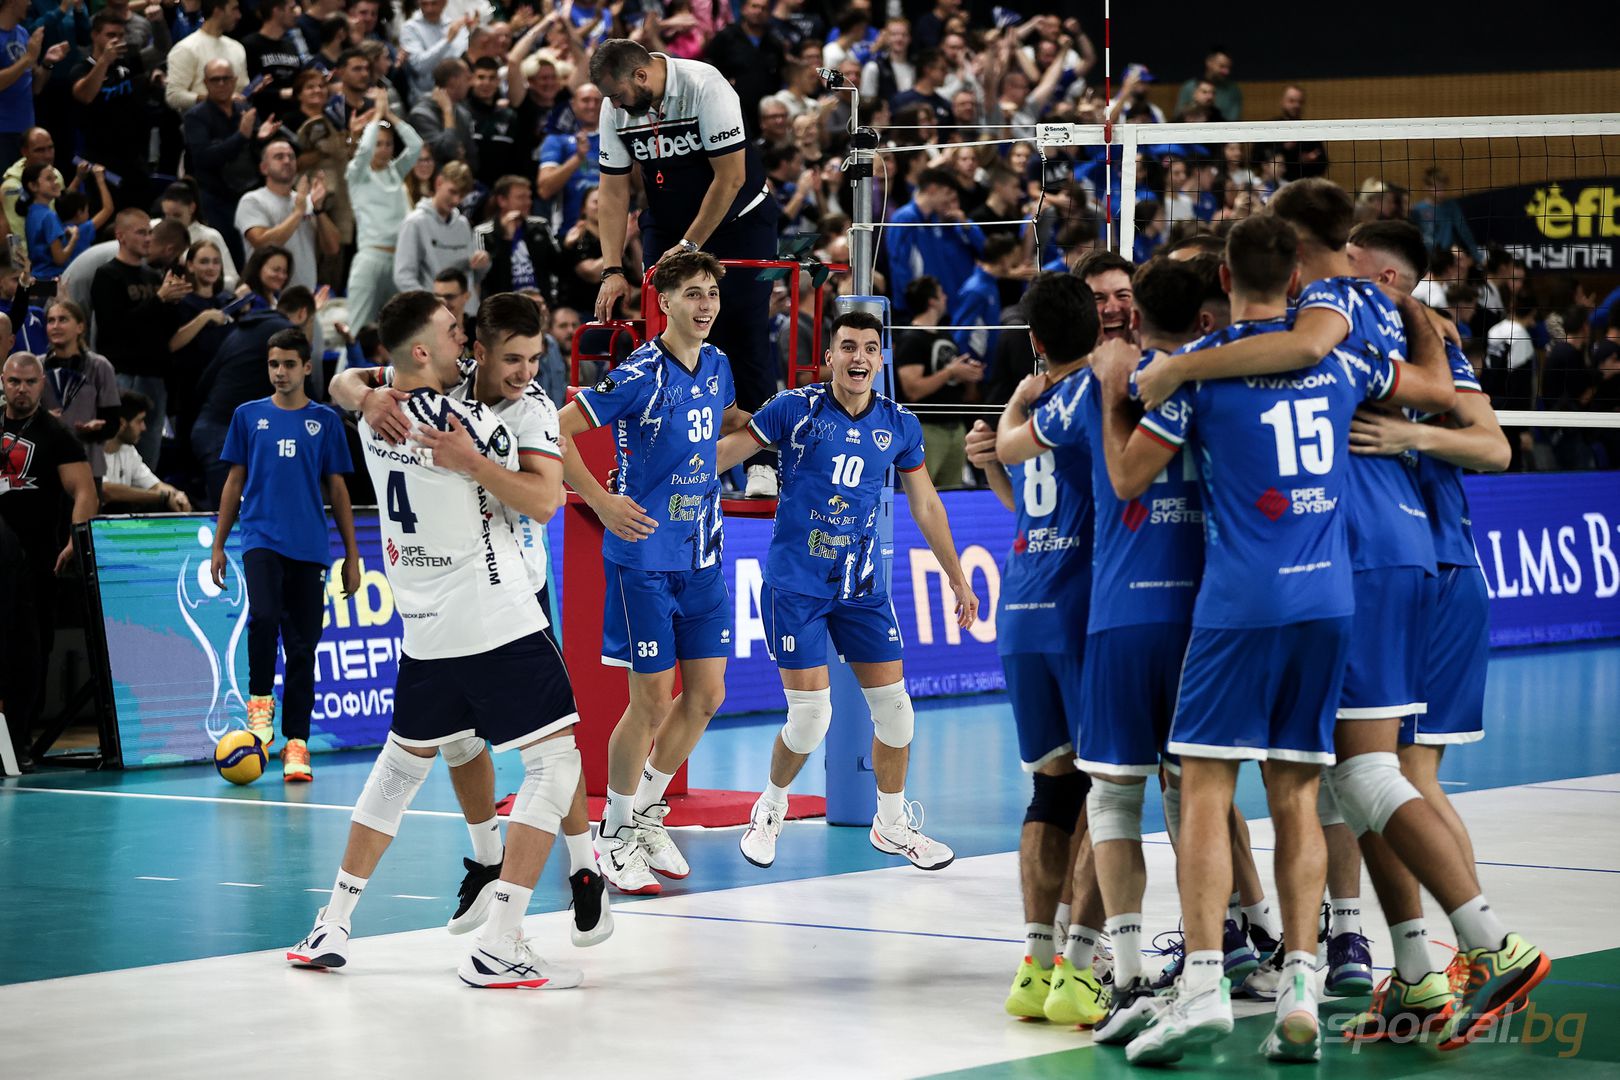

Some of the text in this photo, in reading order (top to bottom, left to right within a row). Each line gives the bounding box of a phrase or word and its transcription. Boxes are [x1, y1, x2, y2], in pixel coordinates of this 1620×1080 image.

[709, 126, 741, 144] efbet
[631, 131, 702, 160] efbet
[1244, 373, 1337, 390] VIVACOM
[687, 406, 713, 443] 33
[1260, 396, 1335, 477] 15
[277, 439, 296, 457] 15
[671, 474, 699, 485] PALMS
[832, 453, 865, 488] 10
[1024, 449, 1057, 517] 8
[387, 470, 418, 533] 4
[1291, 487, 1325, 501] PIPE
[1152, 498, 1187, 511] PIPE
[809, 509, 857, 526] PALMS BET
[1150, 510, 1203, 525] SYSTE
[518, 514, 534, 548] KIN
[1028, 527, 1058, 541] PIPE
[401, 545, 426, 556] PIPE
[1028, 536, 1080, 554] SYSTEM
[401, 556, 452, 567] SYSTEM
[1473, 512, 1620, 599] LMS B
[637, 641, 659, 658] 33
[781, 635, 796, 653] 10
[311, 688, 394, 720] СОФИЯ
